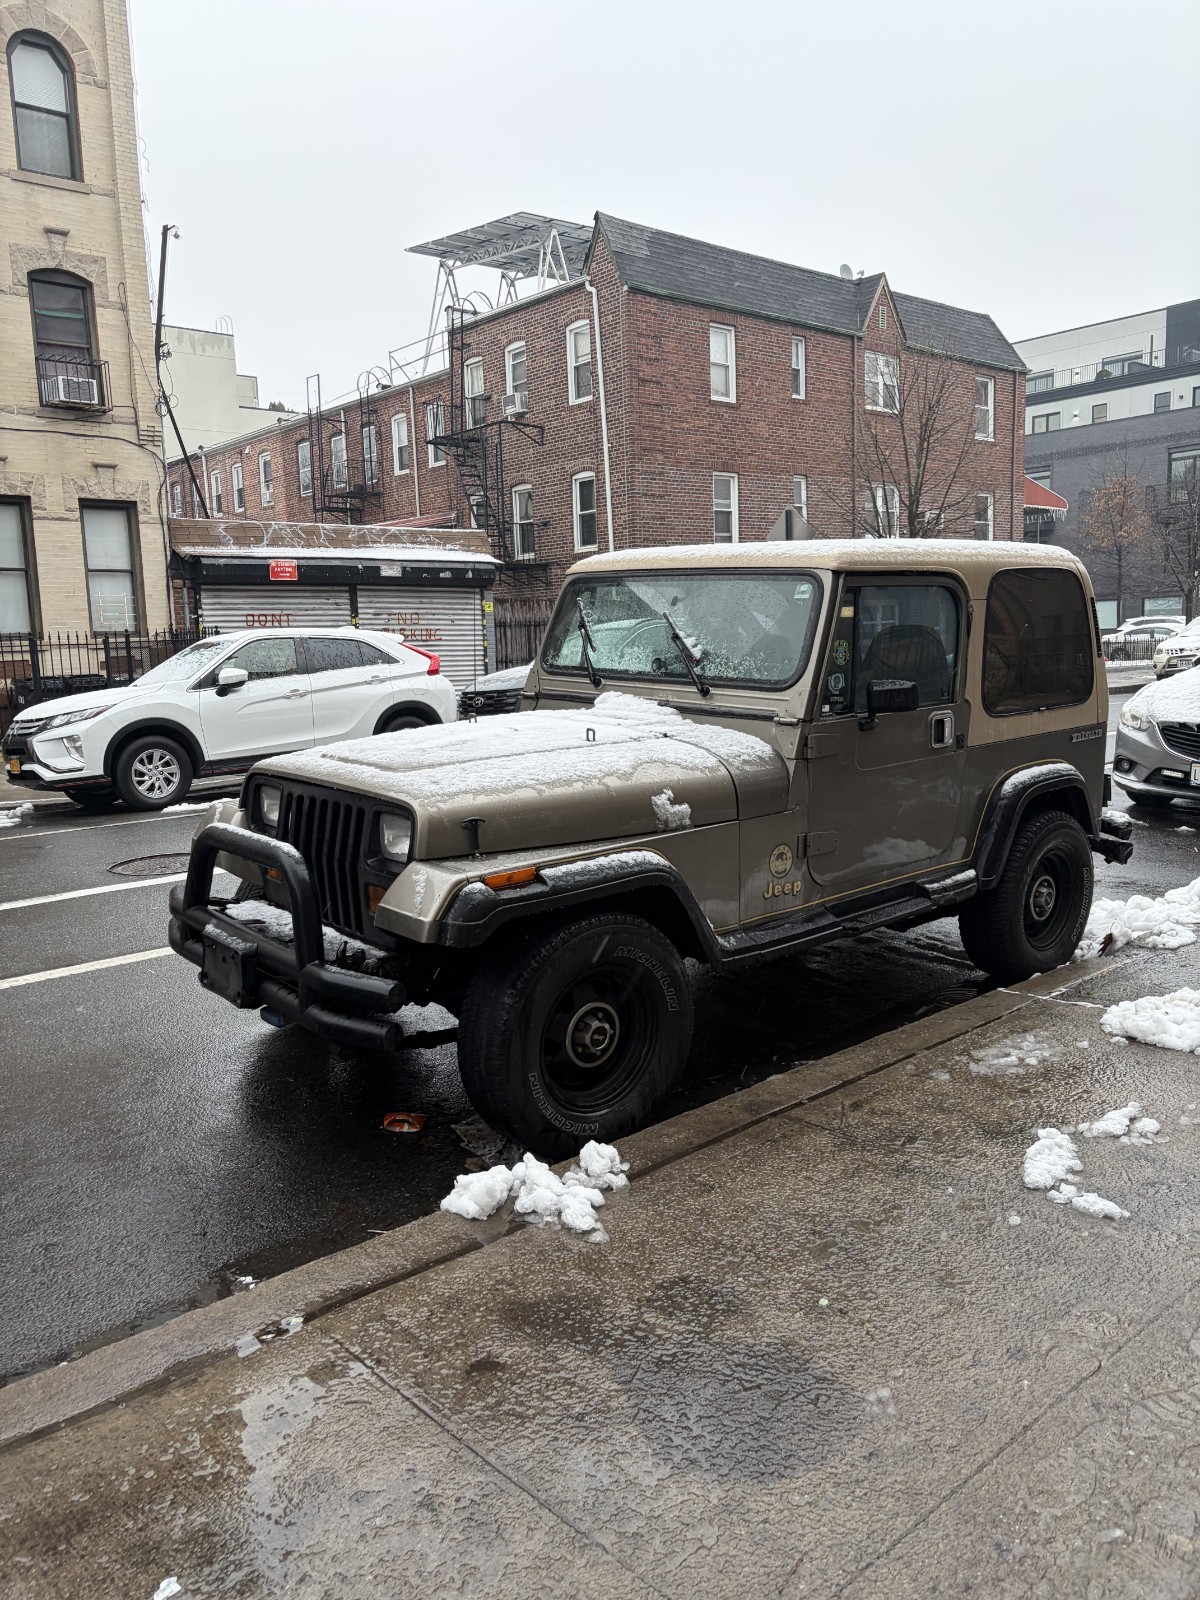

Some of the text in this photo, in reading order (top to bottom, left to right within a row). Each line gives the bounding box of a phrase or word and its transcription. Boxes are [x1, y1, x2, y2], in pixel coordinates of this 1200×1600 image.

[397, 612, 420, 625] NO
[763, 880, 802, 899] Jeep
[1071, 867, 1090, 942] MICHELIN
[613, 945, 679, 1011] MICHELIN
[528, 1072, 599, 1135] MICHELIN
